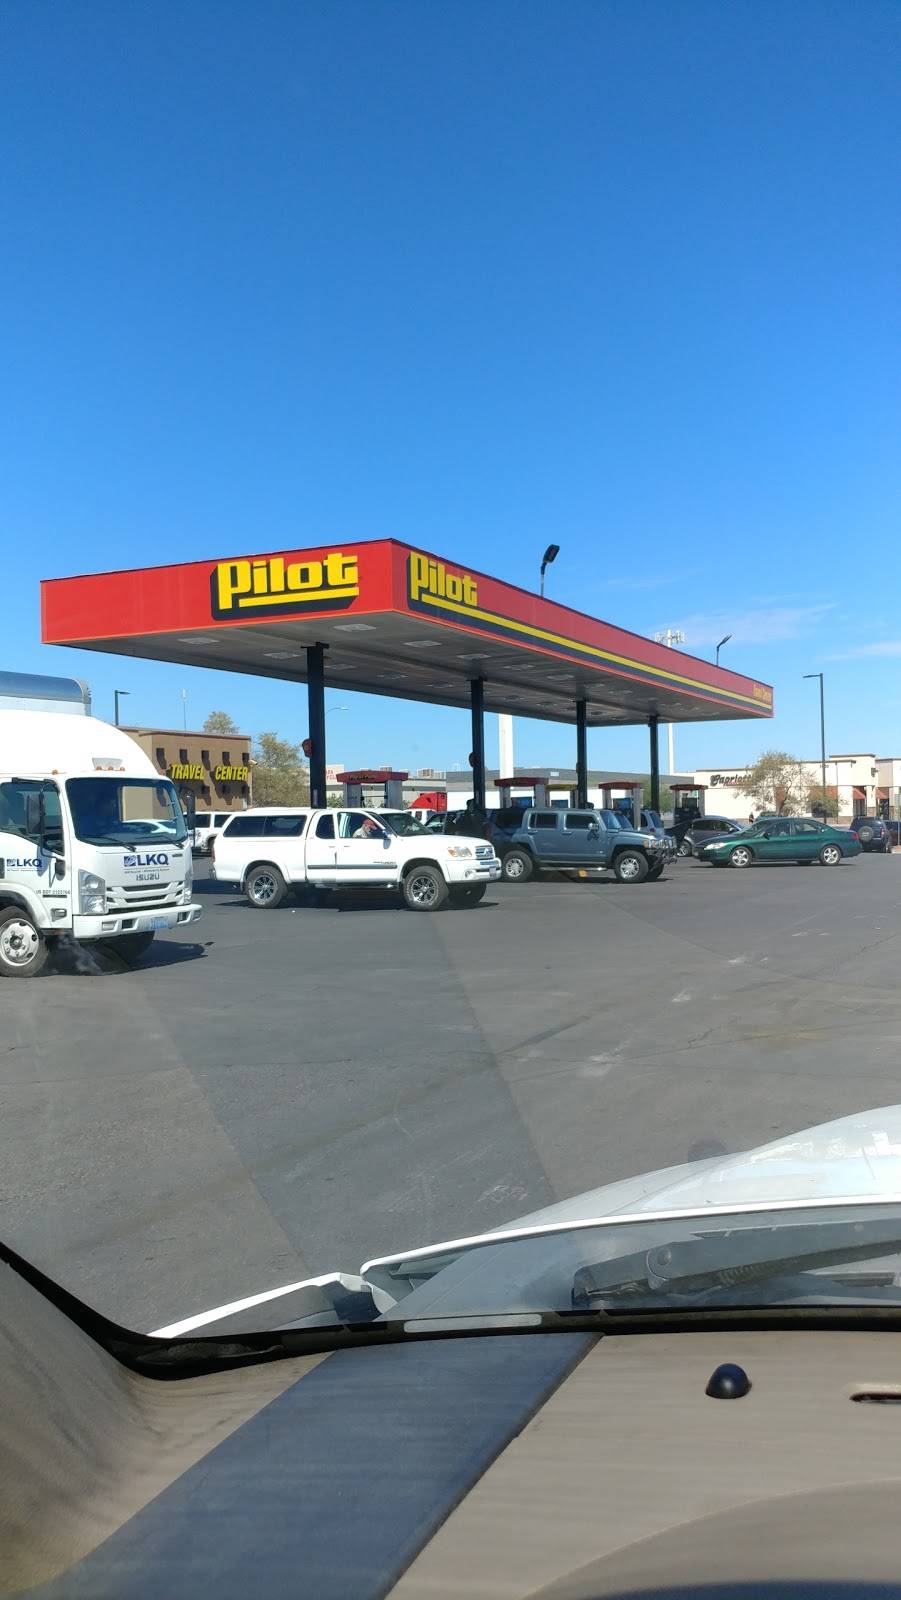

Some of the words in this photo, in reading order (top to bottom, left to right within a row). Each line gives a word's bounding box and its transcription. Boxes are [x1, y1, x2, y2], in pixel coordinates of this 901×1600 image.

[217, 552, 359, 610] Pilot
[410, 551, 478, 607] Pilot
[170, 764, 205, 780] TRAVEL
[215, 766, 249, 781] CENTER
[16, 858, 43, 868] LKQ
[137, 853, 169, 866] LKQ
[136, 873, 160, 881] ISUZU
